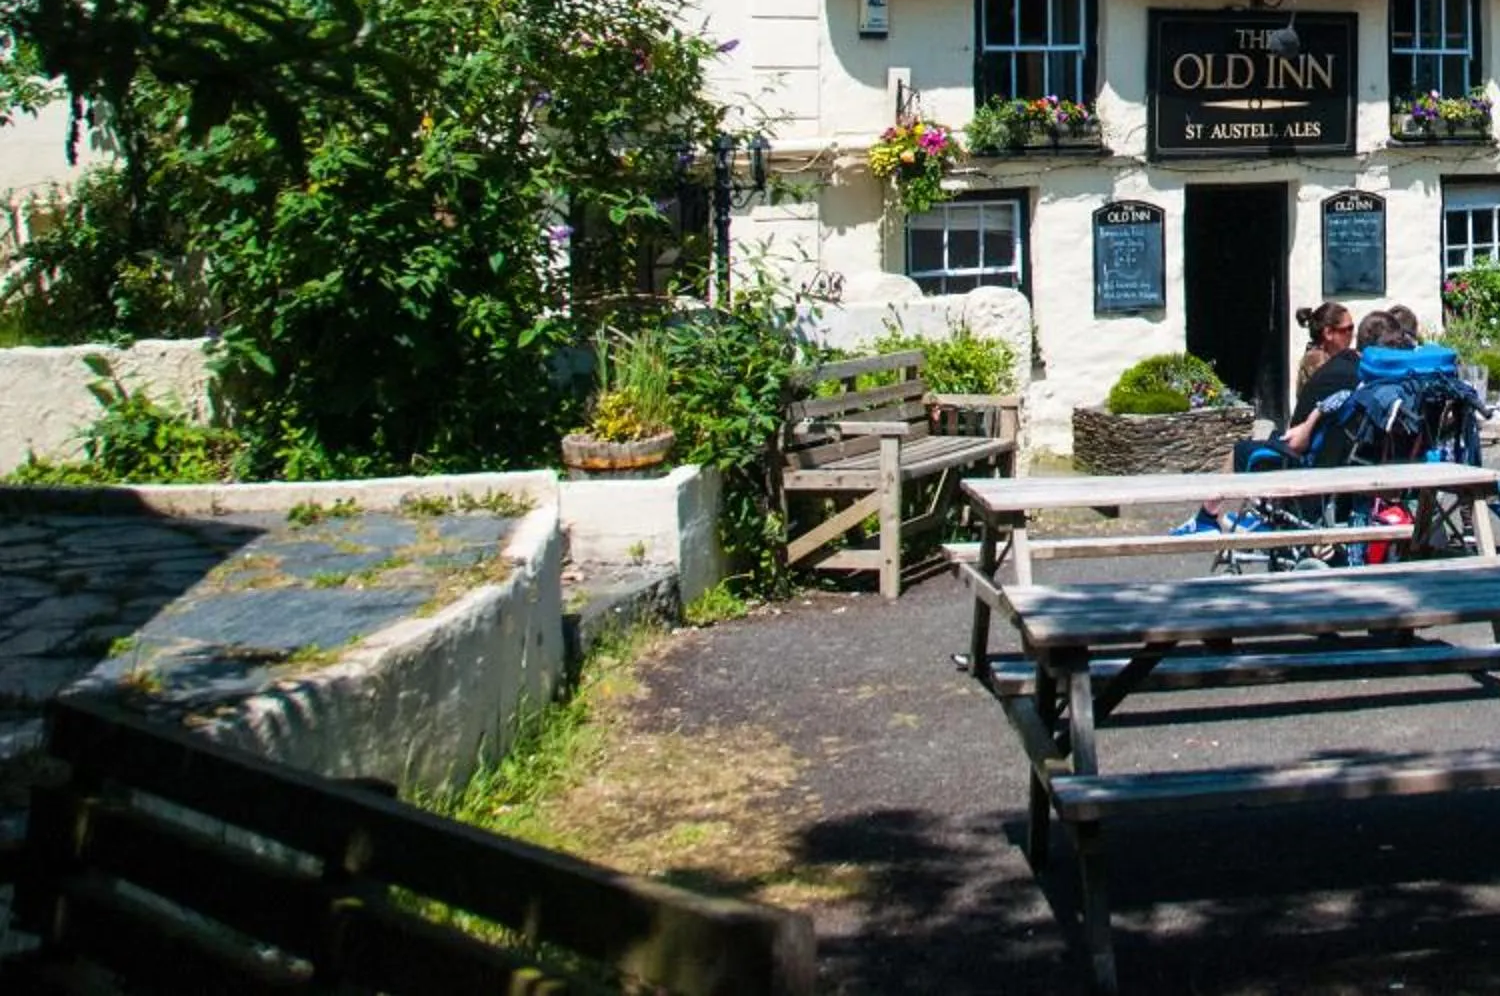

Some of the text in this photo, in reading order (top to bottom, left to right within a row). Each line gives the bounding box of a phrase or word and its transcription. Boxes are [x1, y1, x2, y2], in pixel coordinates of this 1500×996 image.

[1173, 53, 1334, 90] OLD INN
[1185, 121, 1321, 140] ST AUSTELL ALES
[1335, 200, 1373, 211] OLD INN
[1107, 210, 1151, 223] OLD INN
